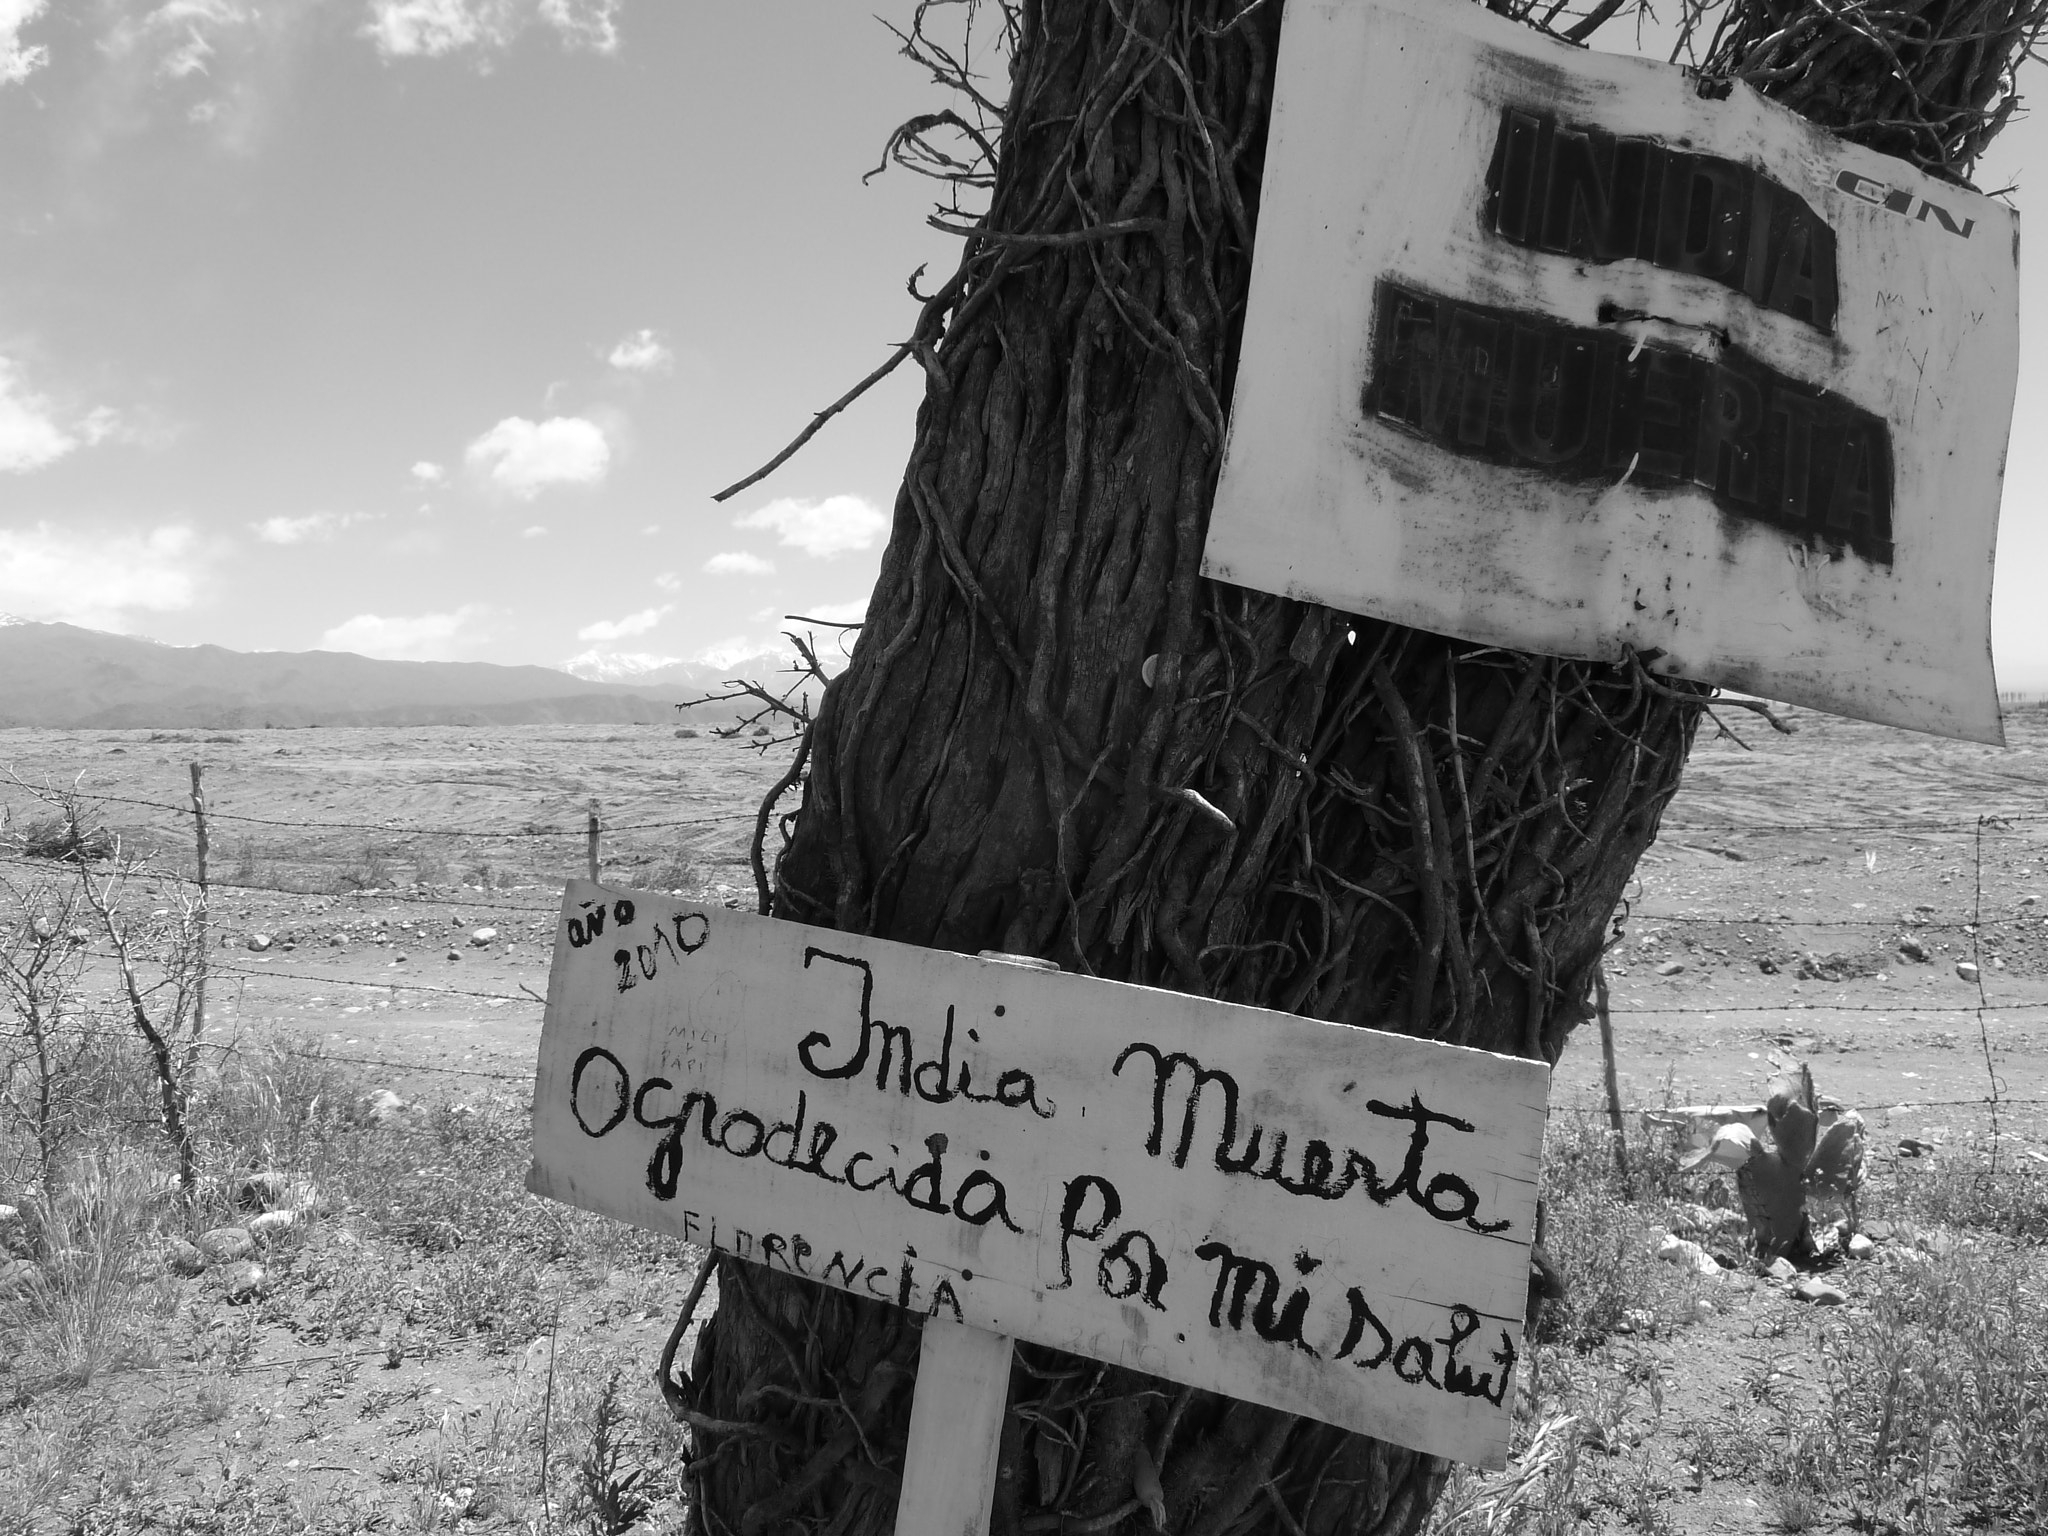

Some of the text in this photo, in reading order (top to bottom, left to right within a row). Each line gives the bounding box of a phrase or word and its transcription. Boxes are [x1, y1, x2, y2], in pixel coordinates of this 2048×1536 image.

[1495, 108, 1839, 335] INDIA
[1377, 286, 1894, 545] MUERTA
[614, 911, 710, 993] 2010
[798, 946, 1512, 1233] India Muerta
